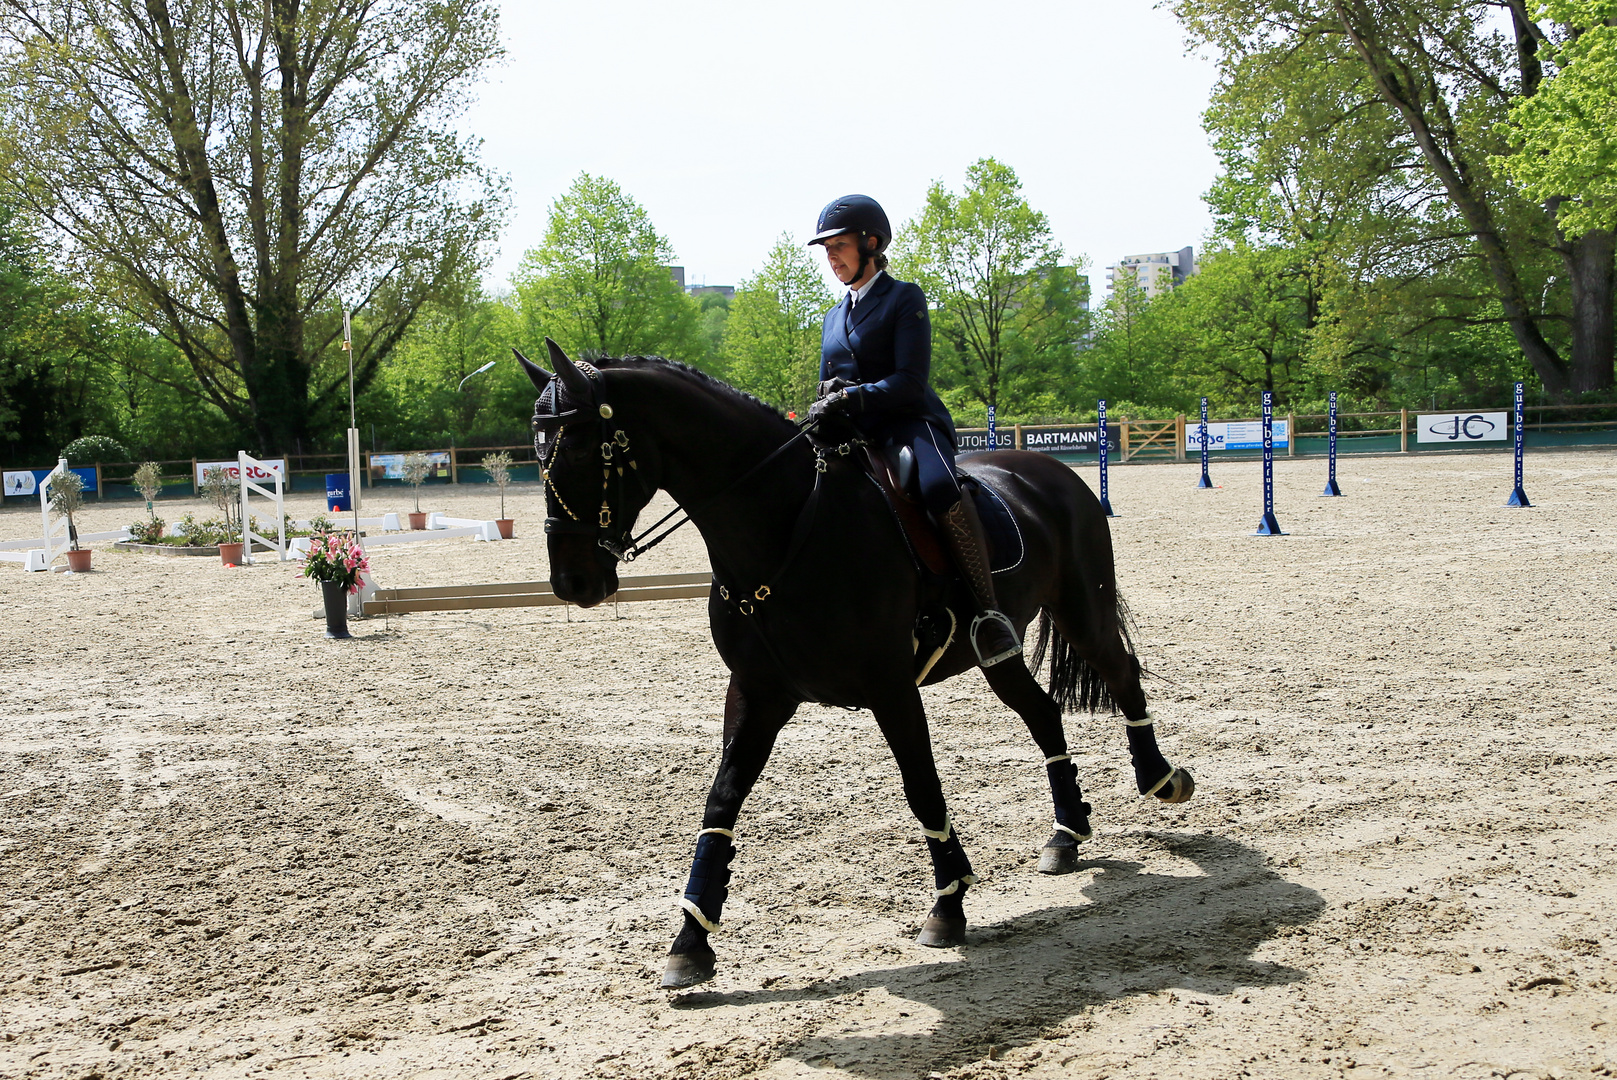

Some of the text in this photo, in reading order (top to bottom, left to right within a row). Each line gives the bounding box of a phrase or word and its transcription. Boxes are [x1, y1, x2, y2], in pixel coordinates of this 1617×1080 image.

[1099, 400, 1107, 446] gurbe
[1263, 393, 1272, 448] gurbe
[1448, 414, 1484, 440] JC
[957, 431, 1097, 448] UTOHUS BARTMANN
